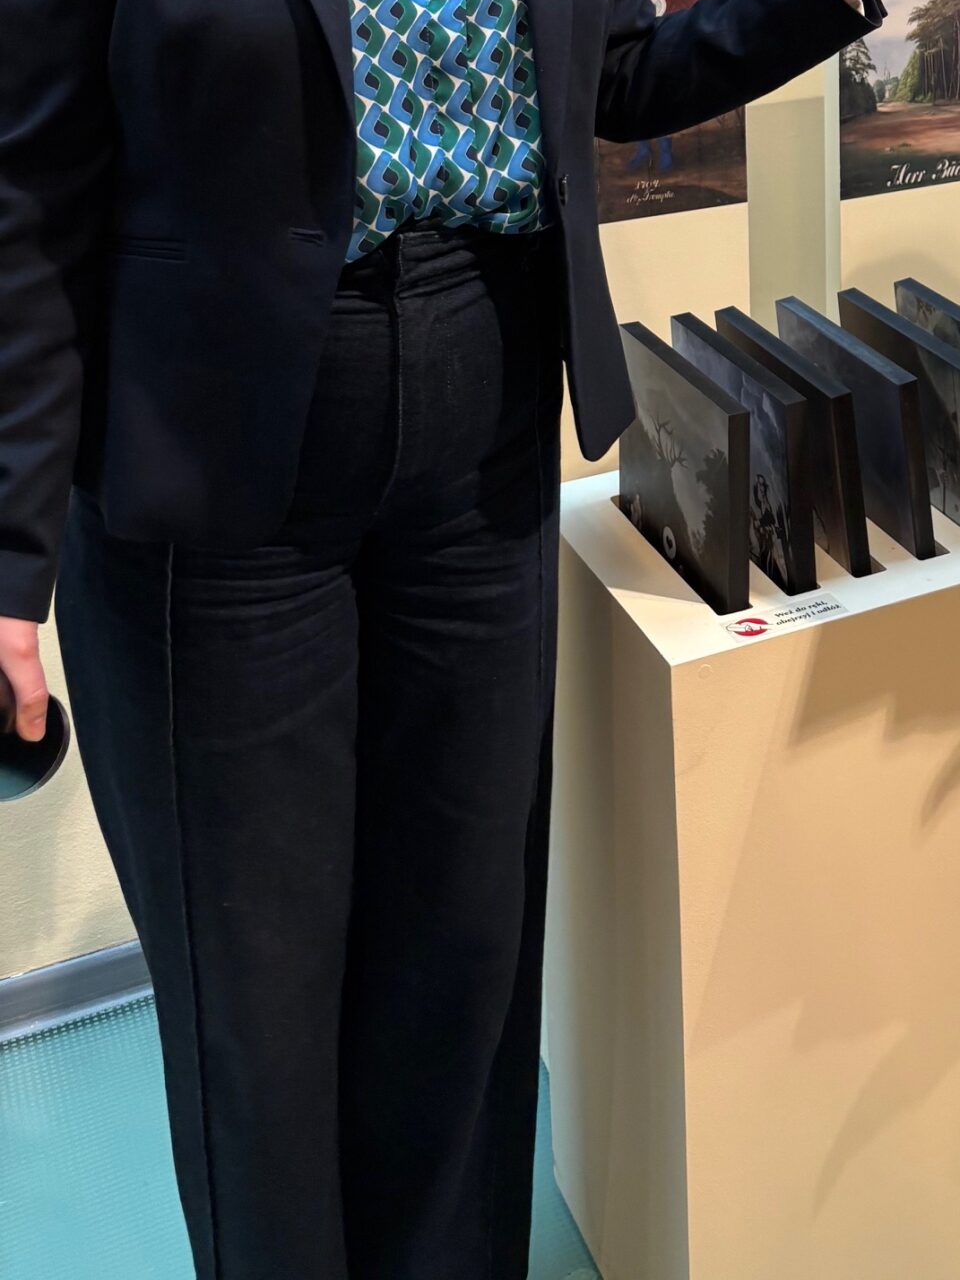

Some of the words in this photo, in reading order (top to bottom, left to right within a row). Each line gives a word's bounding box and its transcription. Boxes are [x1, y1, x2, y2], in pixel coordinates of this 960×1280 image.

[886, 163, 926, 187] Herr
[774, 609, 793, 619] Weź
[795, 605, 807, 613] do
[808, 600, 828, 611] ręki,
[776, 612, 811, 626] obejrzyj
